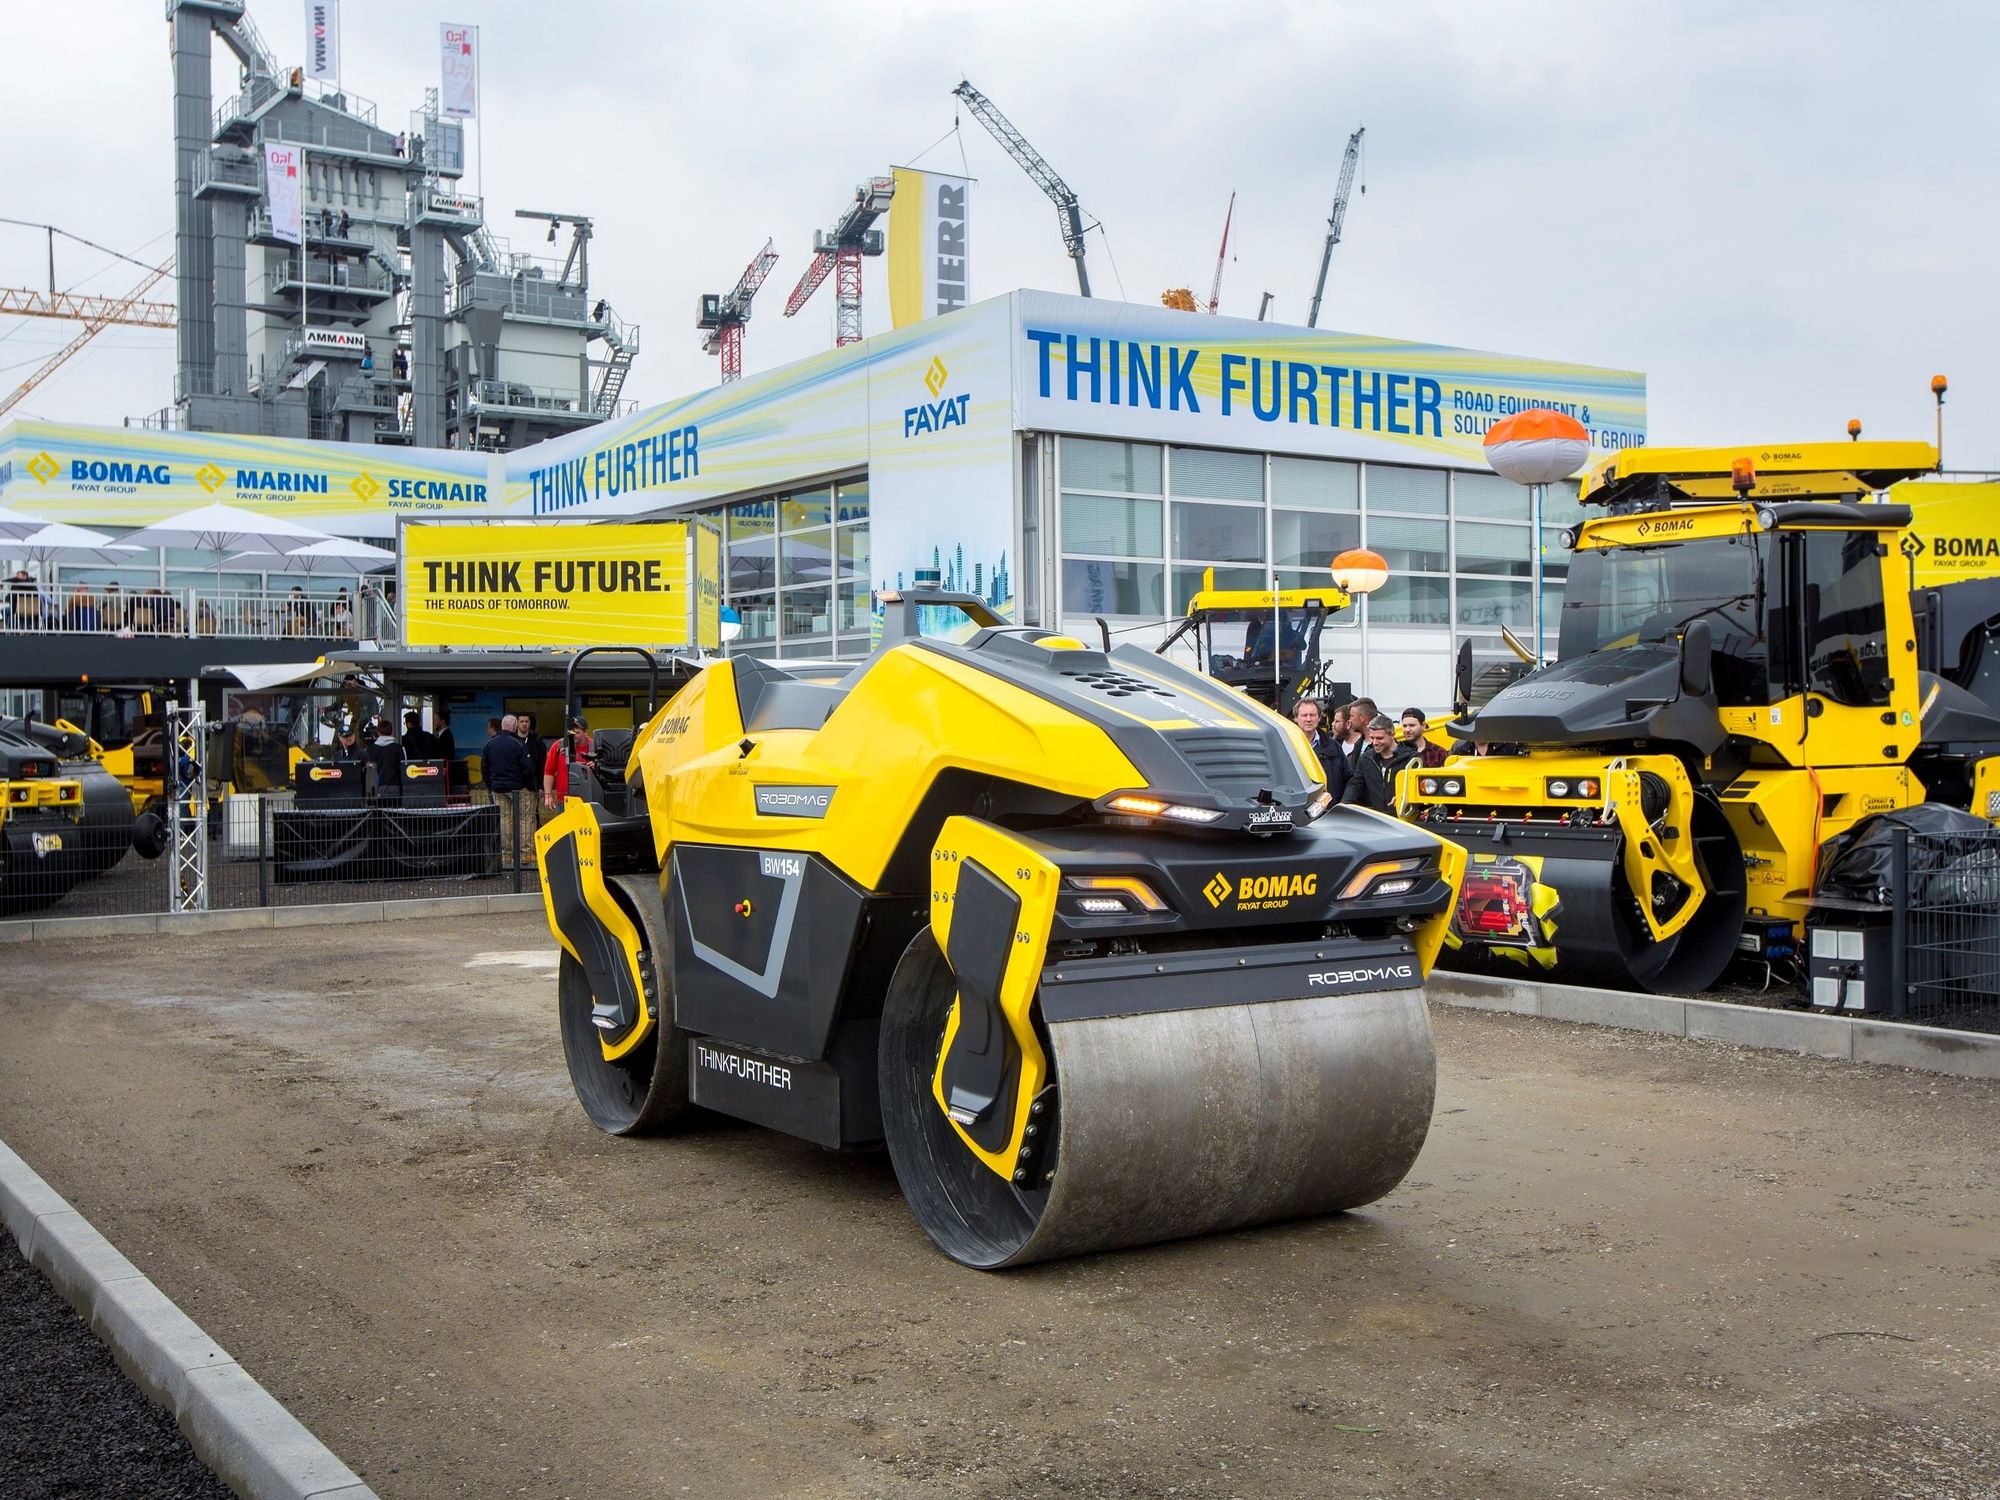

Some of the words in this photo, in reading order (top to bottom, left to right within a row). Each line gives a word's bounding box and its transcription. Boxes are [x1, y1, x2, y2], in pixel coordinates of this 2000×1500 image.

[435, 198, 475, 210] AMMANN
[308, 332, 363, 345] AMMANN
[1027, 329, 1200, 413] THINK
[1221, 353, 1442, 437] FURTHER
[904, 393, 970, 438] FAYAT
[1454, 389, 1493, 412] ROAD
[1581, 405, 1591, 424] &
[1601, 431, 1645, 449] GROUP
[71, 460, 170, 485] BOMAG
[529, 456, 588, 515] THINK
[595, 425, 699, 500] FURTHER
[72, 483, 100, 493] FAYAT
[104, 485, 136, 494] GROUP
[237, 470, 328, 493] MARINI
[388, 479, 487, 502] SECMAIR
[237, 492, 262, 500] FAYAT
[266, 494, 296, 502] GROUP
[388, 501, 412, 509] FAYAT
[415, 502, 443, 510] GROUP
[1654, 519, 1694, 532] BOMAG
[1934, 538, 2000, 556] BOMA
[423, 561, 522, 593] THINK
[534, 560, 671, 592] FUTURE.
[425, 599, 445, 610] THE
[448, 599, 485, 610] ROADS
[488, 599, 501, 610] OF
[504, 599, 570, 610] TOMORROW.
[661, 716, 690, 735] BOMAG
[760, 793, 828, 807] ROBOMAG
[1889, 799, 1895, 808] 2
[765, 857, 800, 876] BW154
[1239, 873, 1317, 899] BOMAG
[1237, 902, 1261, 911] FAYAT
[1262, 900, 1289, 909] GROUP
[1308, 965, 1412, 986] ROBOMAG
